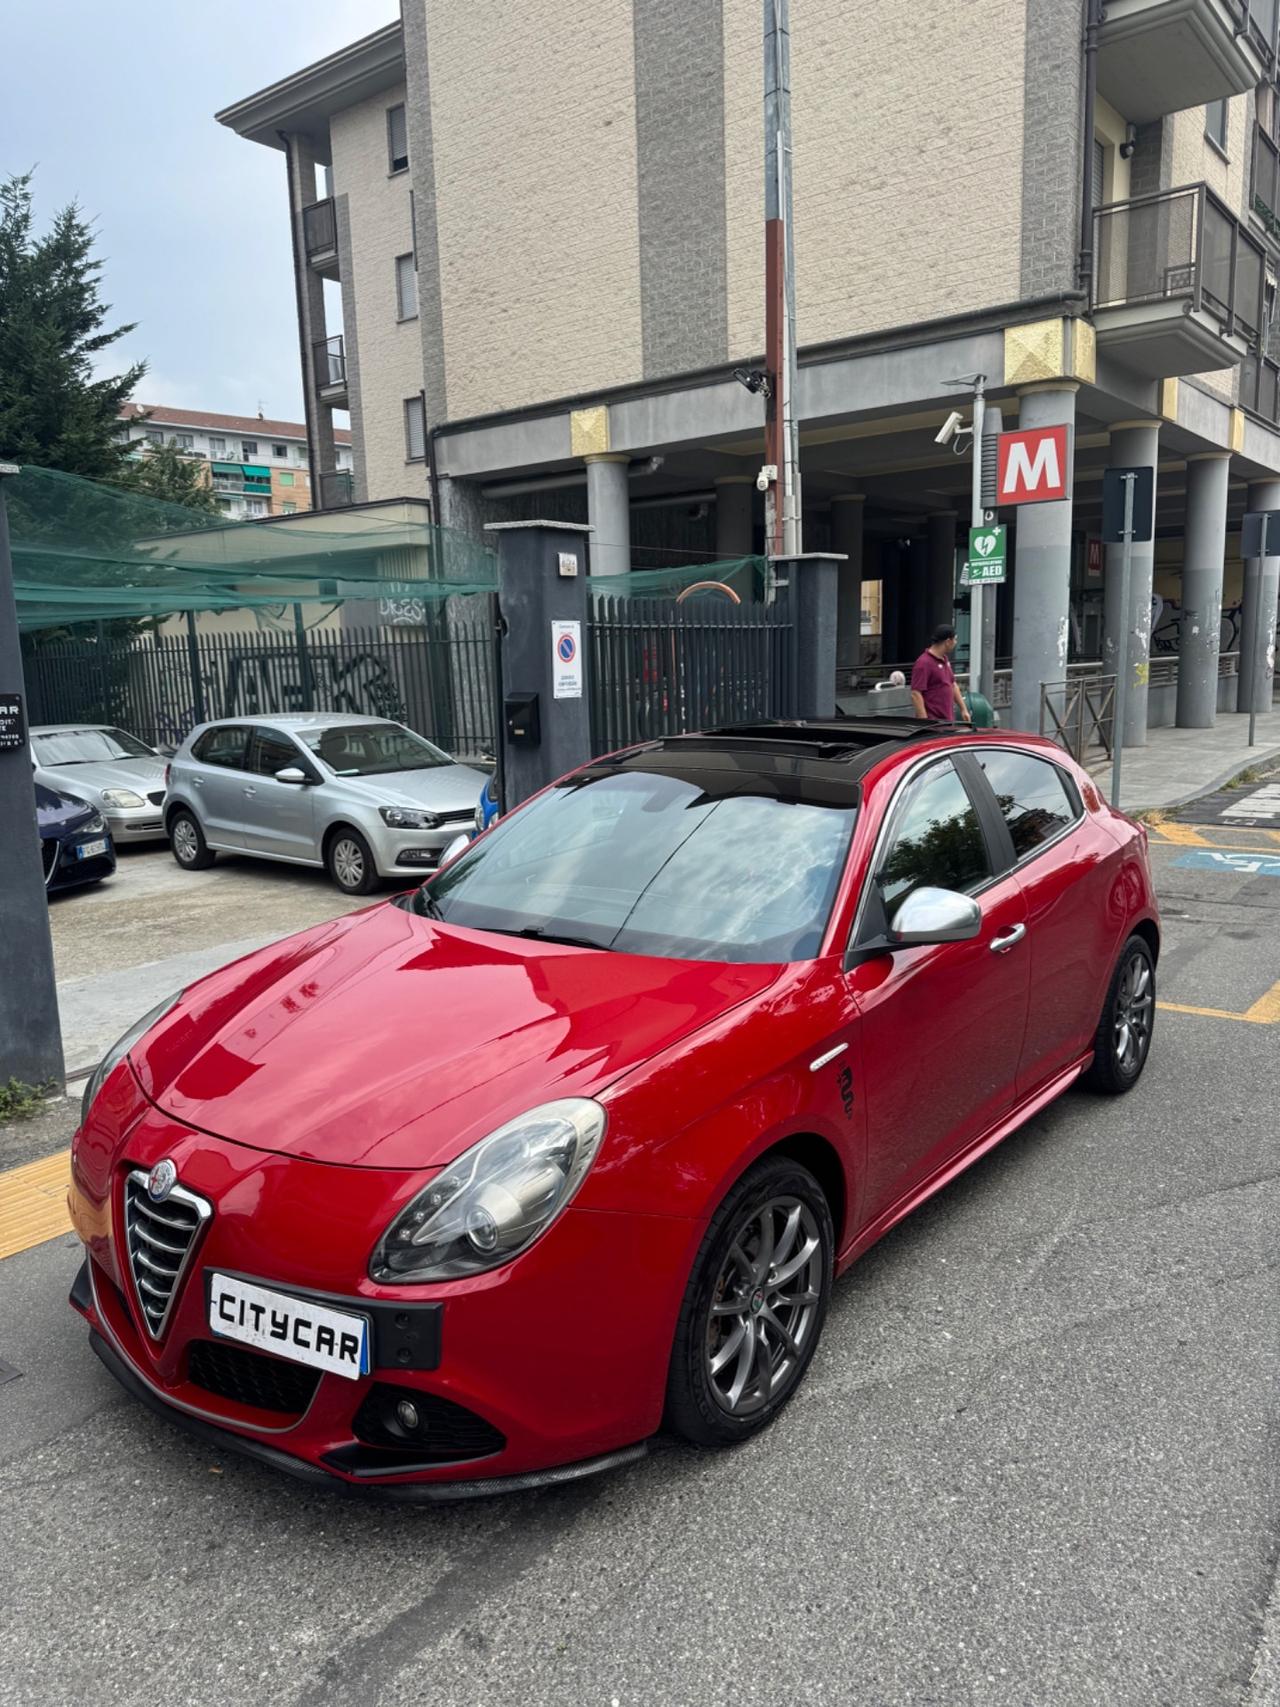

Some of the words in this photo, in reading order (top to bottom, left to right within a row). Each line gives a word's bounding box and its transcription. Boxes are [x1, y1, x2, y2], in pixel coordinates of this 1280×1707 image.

[1003, 438, 1061, 493] M
[982, 565, 1003, 577] AED
[219, 1293, 359, 1364] CITYCAR
